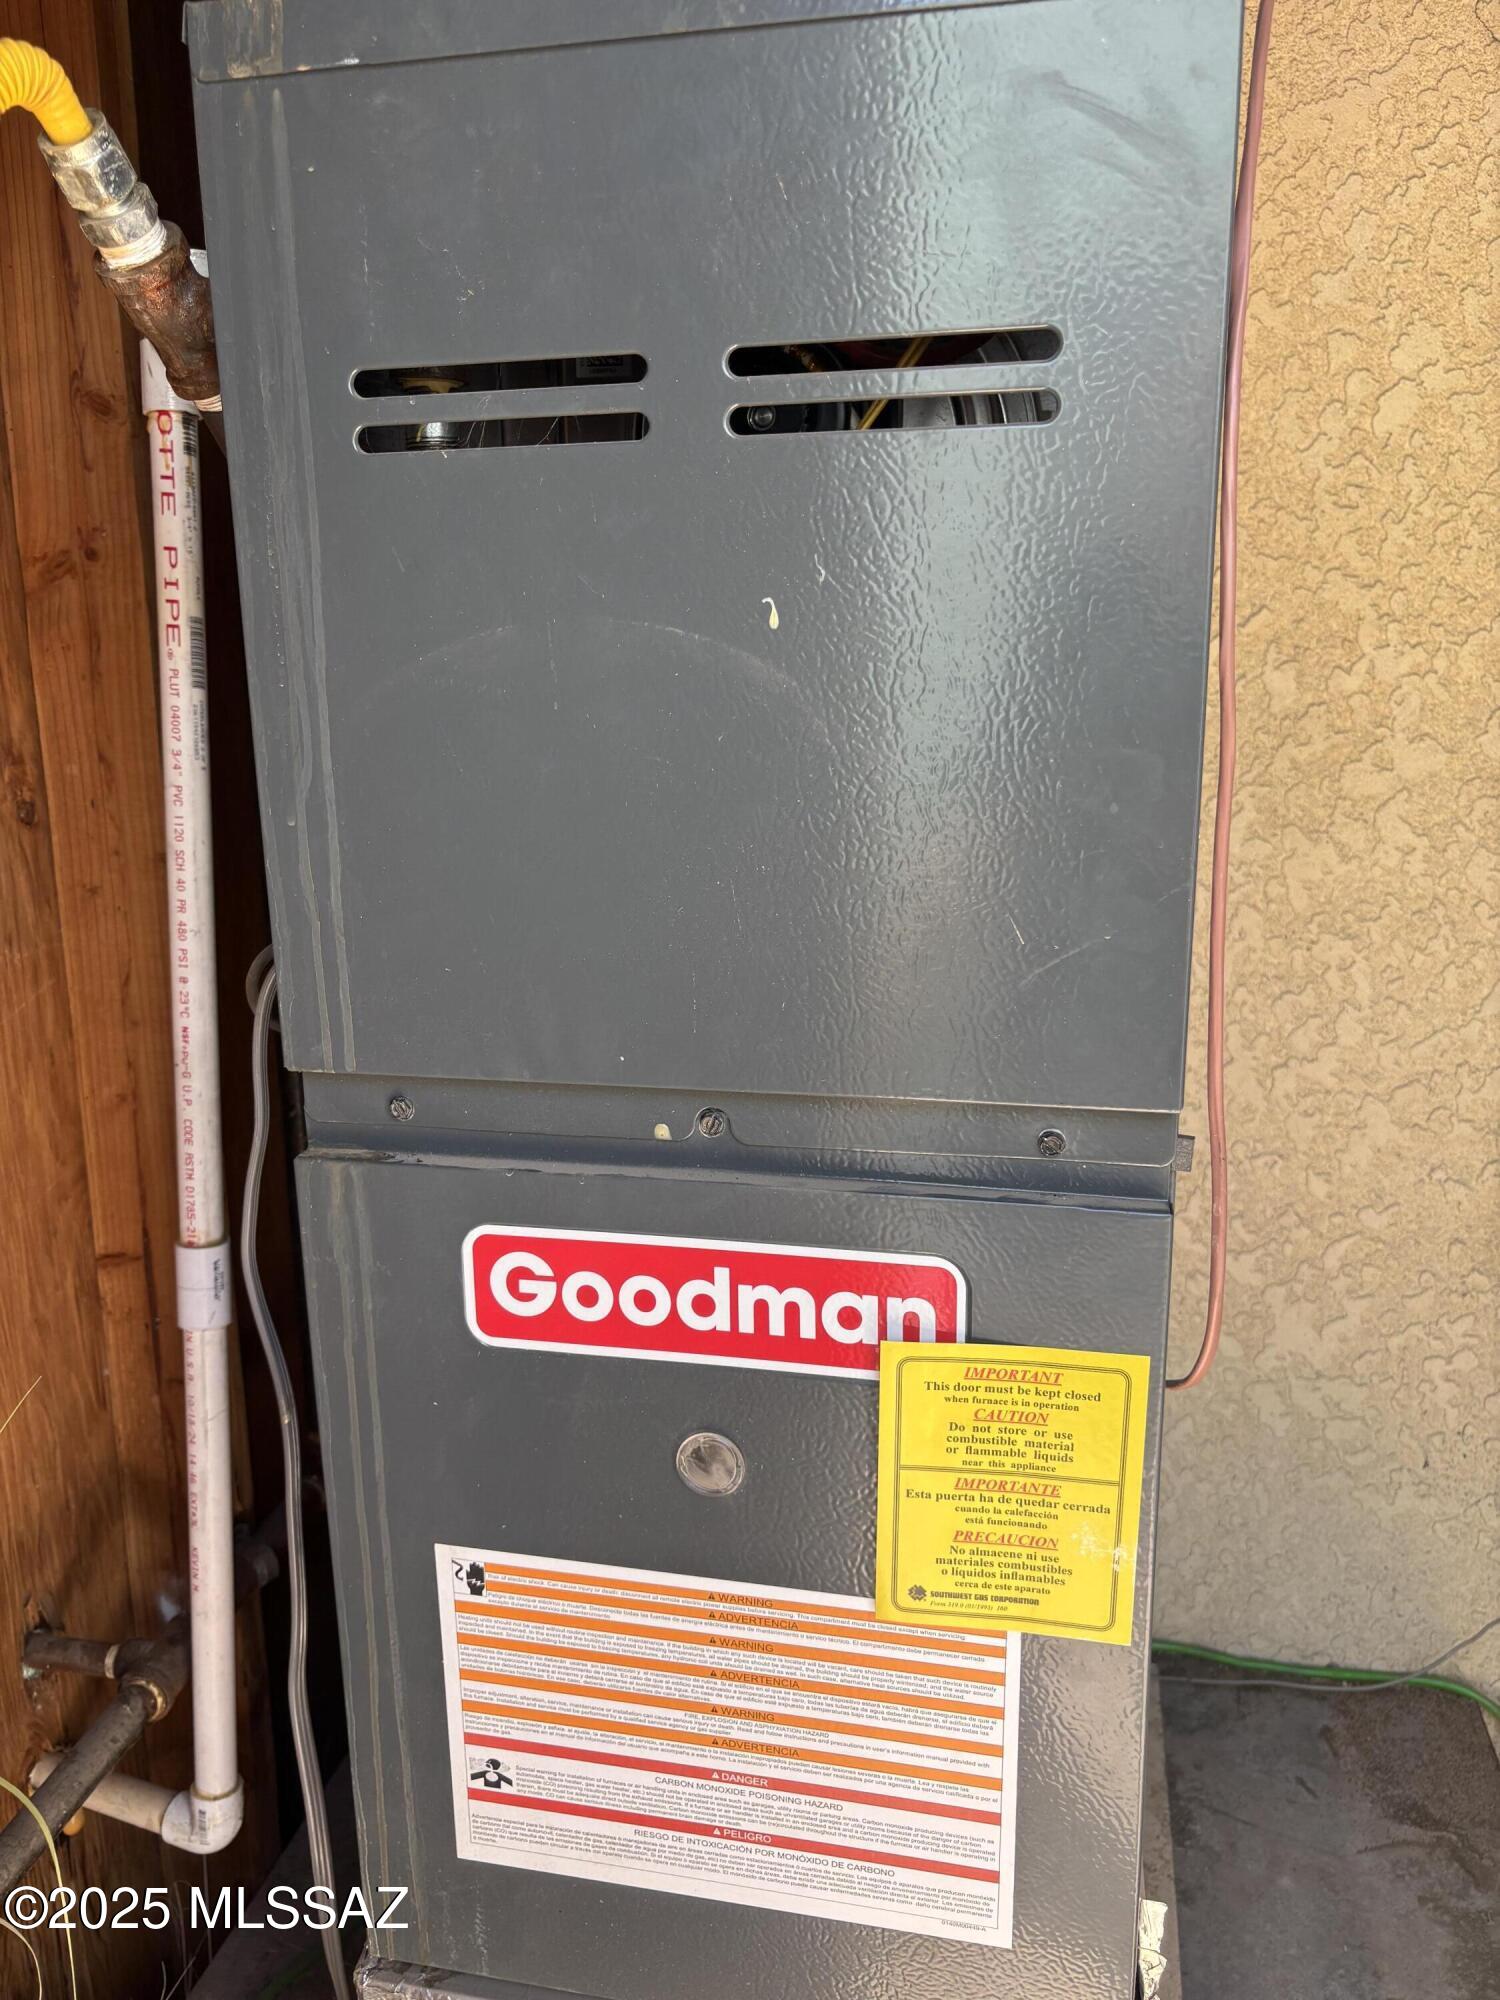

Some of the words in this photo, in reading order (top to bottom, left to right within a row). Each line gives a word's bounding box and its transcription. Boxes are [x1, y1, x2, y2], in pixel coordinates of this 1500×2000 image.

[169, 704, 181, 742] 04007
[172, 784, 183, 806] PVC
[173, 814, 184, 842] 1120
[174, 849, 185, 871] SCH
[175, 878, 186, 891] 40
[176, 898, 187, 913] PR
[176, 920, 187, 941] 480
[177, 947, 188, 968] PSI
[182, 1118, 193, 1144] CODE
[490, 1251, 936, 1345] Goodman
[963, 1366, 1064, 1386] IMPORTANT
[924, 1380, 950, 1391] This
[953, 1382, 981, 1392] door
[984, 1385, 1013, 1394] must
[1017, 1385, 1031, 1395] be
[1034, 1386, 1060, 1400] kept
[1064, 1389, 1101, 1401] closed
[944, 1394, 969, 1403] when
[972, 1396, 1008, 1405] furnace
[1021, 1398, 1030, 1406] in
[1033, 1401, 1079, 1412] operation
[973, 1408, 1049, 1426] CAUTION
[949, 1421, 965, 1432] Do
[972, 1424, 990, 1433] not
[997, 1426, 1027, 1435] store
[1053, 1432, 1073, 1440] use
[946, 1432, 1017, 1447] combustible
[1024, 1439, 1074, 1451] material
[945, 1446, 958, 1454] or
[965, 1445, 1027, 1458] flammable
[1033, 1450, 1074, 1464] liquids
[988, 1459, 1005, 1468] this
[1010, 1461, 1056, 1473] appliance
[954, 1476, 1061, 1498] IMPORTANTE
[905, 1488, 931, 1499] Esta
[935, 1491, 975, 1504] puerta
[979, 1493, 993, 1503] ha
[997, 1495, 1012, 1504] de
[1015, 1496, 1059, 1510] quedar
[1062, 1501, 1110, 1514] cerrada
[954, 1503, 990, 1514] cuando
[993, 1506, 1002, 1514] la
[1004, 1507, 1058, 1519] calefacción
[964, 1515, 983, 1524] está
[986, 1517, 1048, 1529] funcionando
[953, 1529, 1058, 1551] PRECAUCION
[949, 1545, 965, 1555] No
[968, 1546, 1022, 1559] almacene
[1026, 1551, 1037, 1560] ni
[1040, 1555, 1059, 1563] use
[935, 1554, 994, 1569] materiales
[997, 1559, 1072, 1575] combustibles
[951, 1566, 996, 1581] líquidos
[999, 1570, 1066, 1585] inflamables
[930, 1589, 972, 1600] SOUTHWEST
[974, 1593, 988, 1601] GAS
[990, 1594, 1039, 1606] CORPORATION
[981, 1581, 992, 1589] de
[994, 1582, 1012, 1591] este
[1014, 1585, 1051, 1596] aparato
[717, 1592, 773, 1608] WARNING
[717, 1611, 799, 1630] ADVERTENCIA
[719, 1637, 773, 1653] WARNING
[719, 1669, 800, 1689] ADVERTENCIA
[720, 1706, 774, 1721] WARNING
[701, 1714, 737, 1725] EXPLOSION
[739, 1719, 753, 1727] AND
[753, 1721, 801, 1734] ASPHYXIATION
[802, 1728, 829, 1738] HAZARD
[720, 1737, 800, 1757] ADVERTENCIA
[721, 1772, 768, 1787] DANGER
[654, 1776, 694, 1788] CARBON
[695, 1782, 746, 1797] MONOXIDE
[748, 1790, 802, 1805] POISONING
[804, 1798, 843, 1811] HAZARD
[723, 1828, 771, 1843] PELIGRO
[633, 1828, 669, 1841] RIESGO
[671, 1834, 684, 1843] DE
[686, 1836, 752, 1854] INTOXICACIÓN
[754, 1847, 775, 1857] POR
[777, 1851, 828, 1866] MONÓXIDO
[831, 1860, 844, 1869] DE
[846, 1863, 895, 1877] CARBONO
